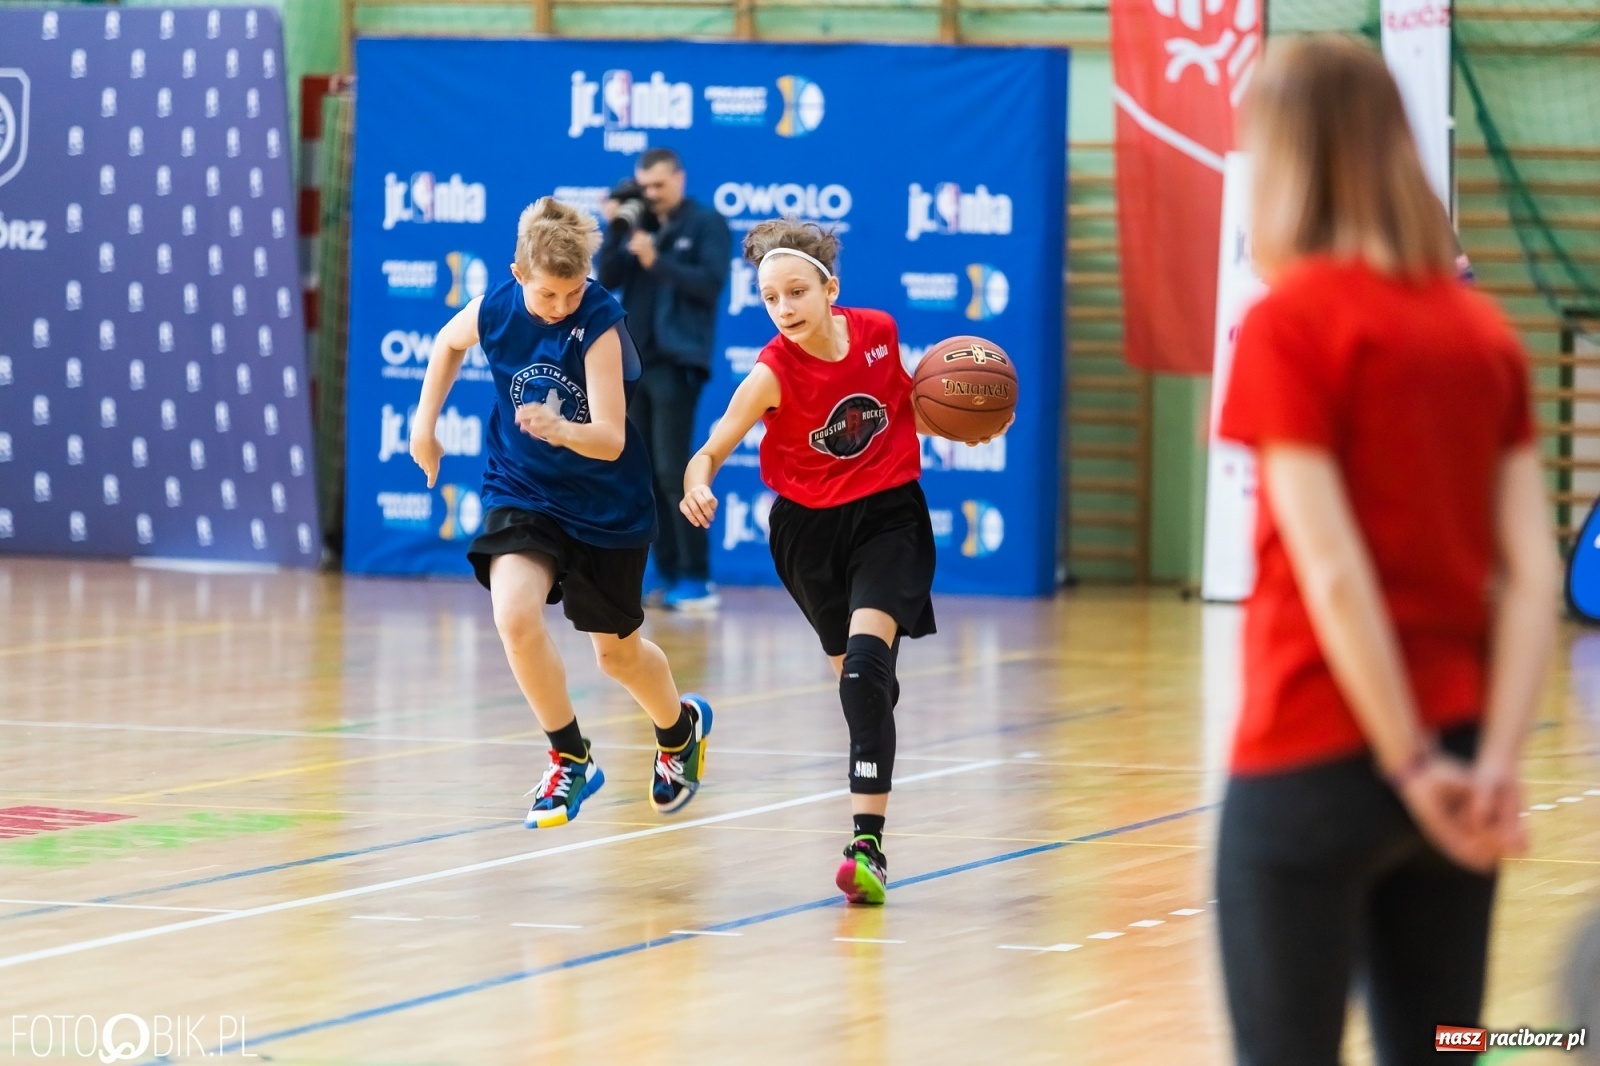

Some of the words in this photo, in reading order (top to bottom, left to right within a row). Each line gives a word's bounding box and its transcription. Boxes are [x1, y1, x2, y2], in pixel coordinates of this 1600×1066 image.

[632, 71, 693, 129] nba
[944, 380, 1009, 400] SPALDING
[814, 420, 846, 440] HOUSTON
[861, 761, 877, 778] NBA
